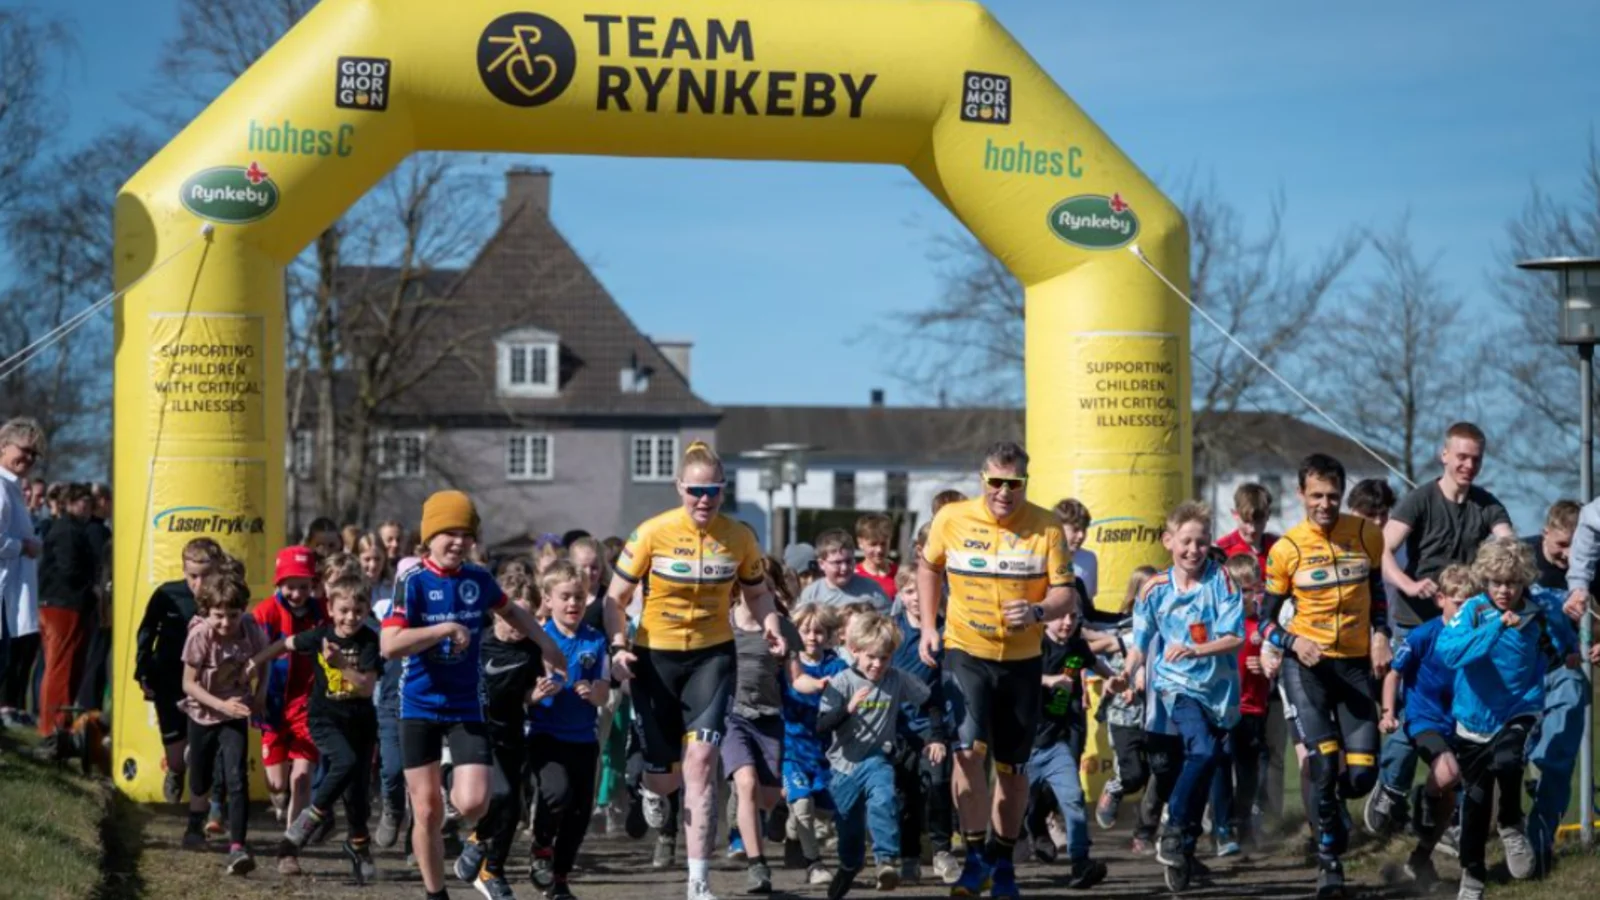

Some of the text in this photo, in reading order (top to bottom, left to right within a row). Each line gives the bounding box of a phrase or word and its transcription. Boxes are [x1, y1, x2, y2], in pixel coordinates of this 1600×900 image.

[584, 14, 755, 61] TEAM
[341, 61, 386, 77] GOD
[340, 76, 384, 91] MOR
[967, 76, 1007, 92] GOD
[596, 65, 877, 118] RYNKEBY
[966, 91, 1006, 106] MOR
[191, 184, 269, 206] Rynkeby
[1058, 211, 1131, 235] Rynkeby
[161, 344, 254, 358] SUPPORTING
[172, 362, 245, 375] CHILDREN
[1086, 361, 1173, 375] SUPPORTING
[155, 381, 261, 394] WITH CRITICAL
[1096, 379, 1165, 392] CHILDREN
[172, 400, 246, 413] ILLNESSES
[1080, 397, 1176, 410] WITH CRITICAL
[1097, 415, 1165, 428] ILLNESSES
[964, 539, 991, 551] DSV
